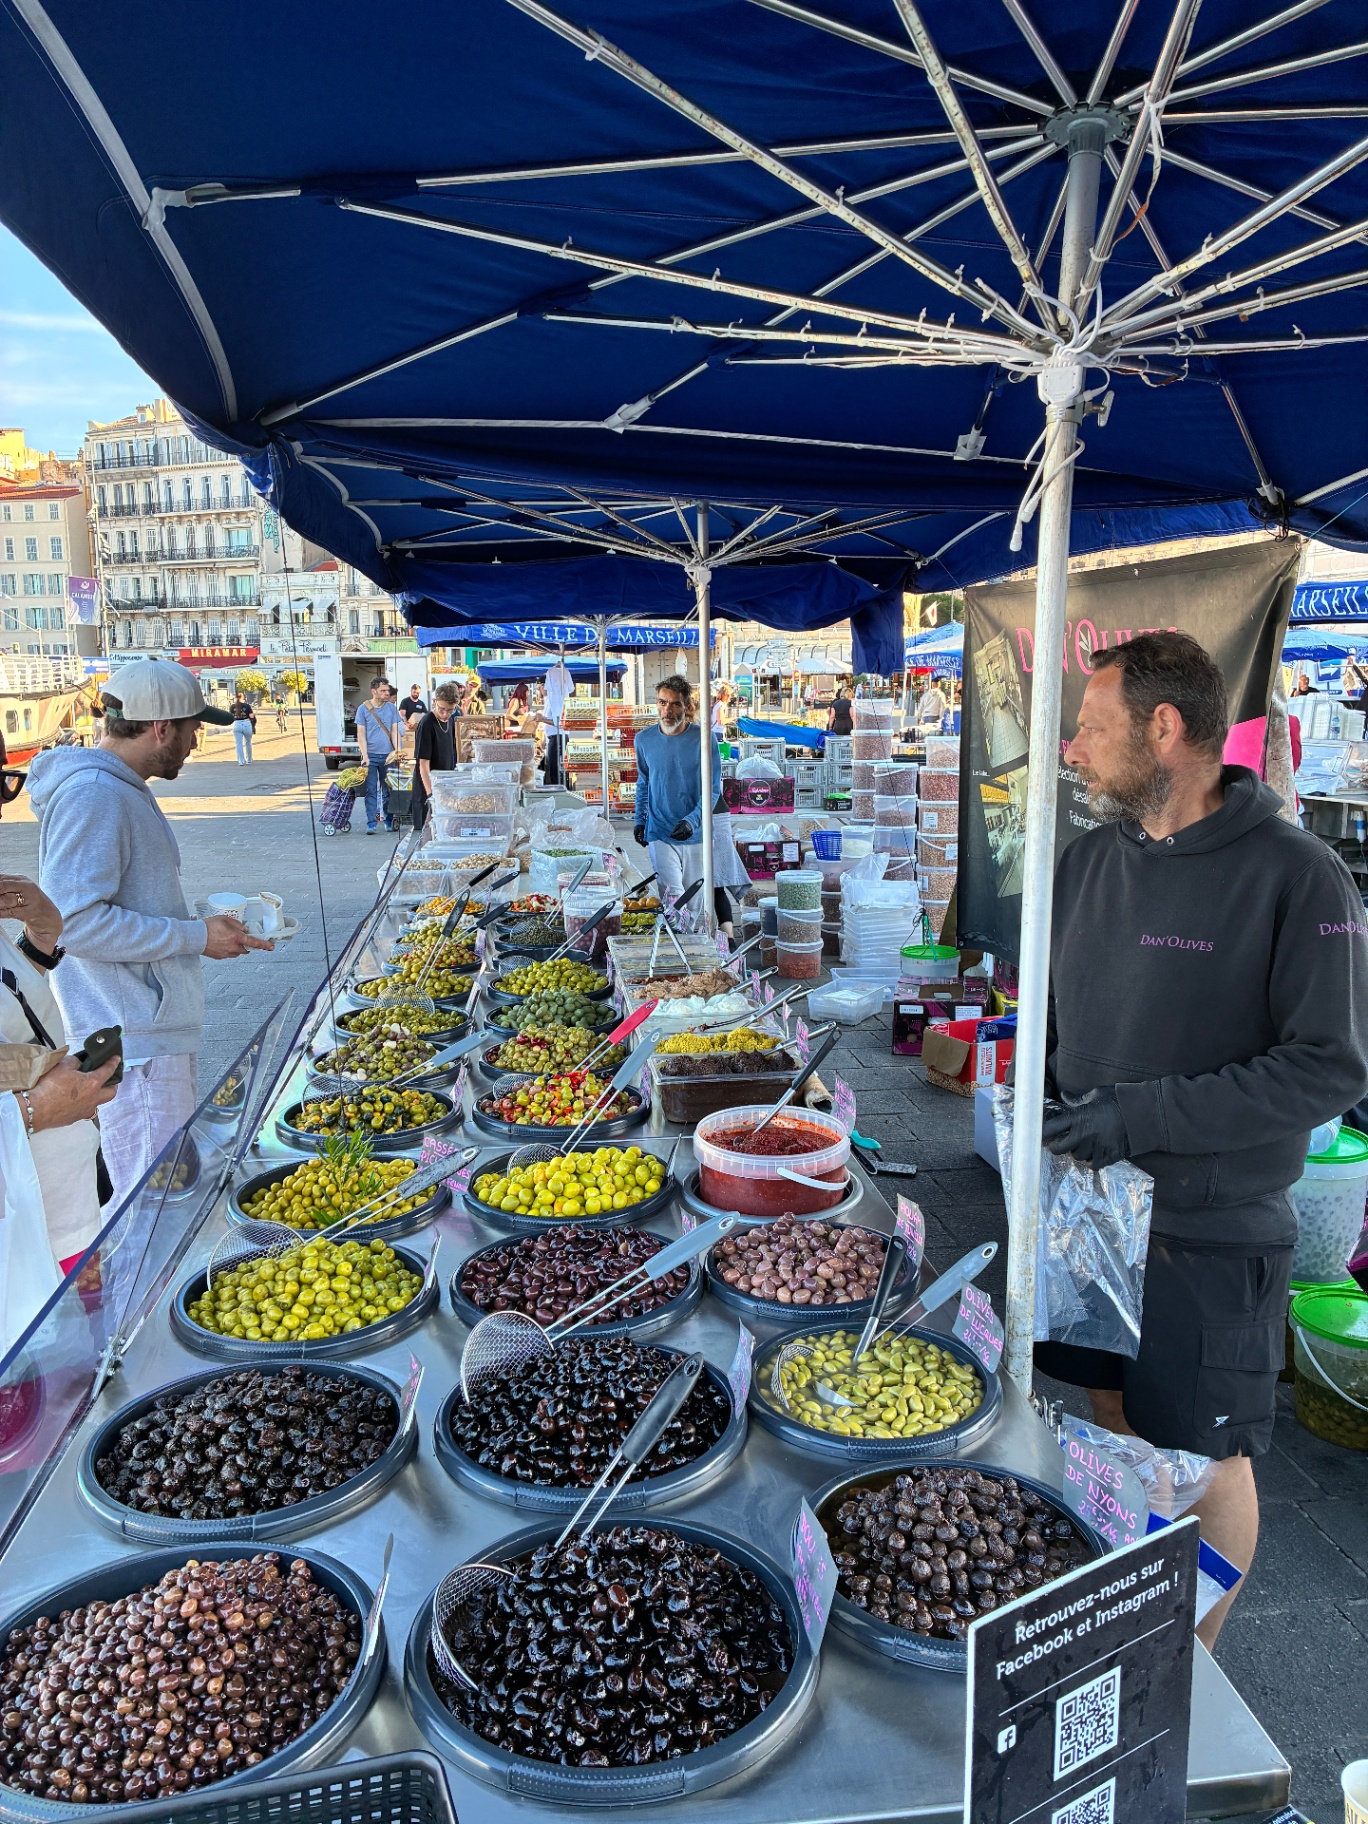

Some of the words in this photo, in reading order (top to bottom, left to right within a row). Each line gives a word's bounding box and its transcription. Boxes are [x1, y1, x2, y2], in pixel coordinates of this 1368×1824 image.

[191, 648, 247, 657] MIRAMAR
[513, 625, 577, 641] VILLE
[616, 628, 700, 646] MARSEILL
[959, 1304, 971, 1320] DE
[970, 1315, 1003, 1353] LUCQUES
[965, 1286, 995, 1325] OLIVES
[1069, 1441, 1124, 1490] OLIVES
[1065, 1464, 1084, 1487] DE
[1088, 1480, 1138, 1530] NYONS
[996, 1627, 1074, 1681] Facebook
[1076, 1618, 1092, 1637] et
[1094, 1578, 1171, 1629] Instagram
[1173, 1571, 1179, 1587] !
[1015, 1571, 1137, 1645] Retrouvez-nous
[1140, 1558, 1165, 1576] sur
